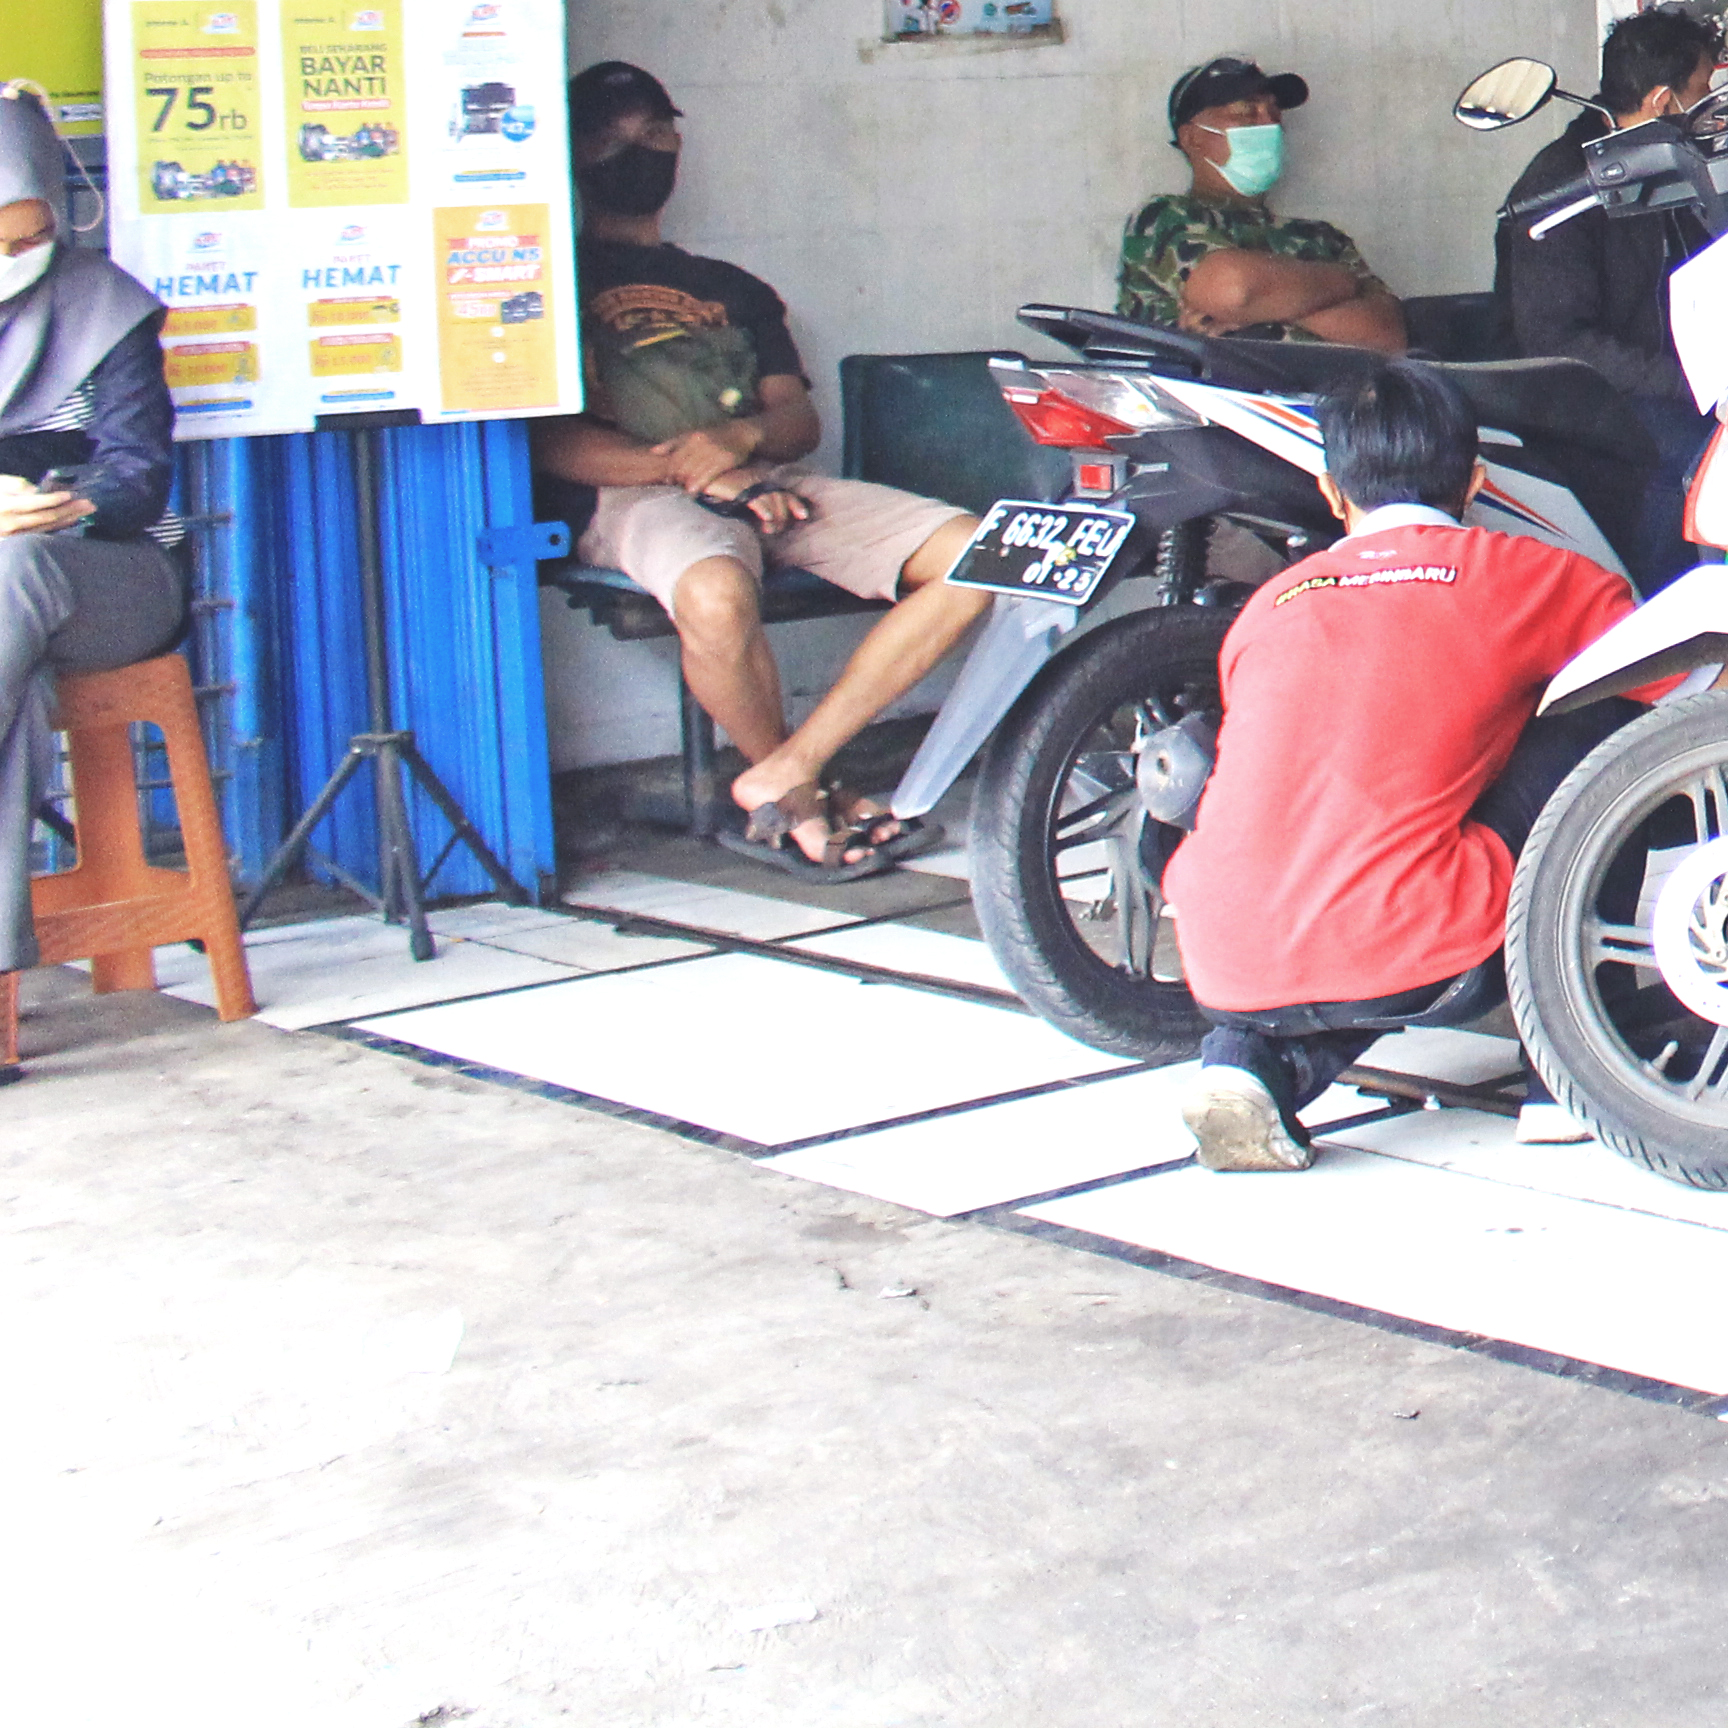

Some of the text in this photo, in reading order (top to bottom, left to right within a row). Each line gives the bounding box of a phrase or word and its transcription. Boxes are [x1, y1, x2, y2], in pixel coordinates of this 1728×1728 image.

[301, 55, 386, 76] BAYAR
[144, 72, 251, 85] Potongan up to
[303, 77, 387, 97] NANTI
[145, 86, 247, 133] 75 rb
[447, 250, 507, 265] ACCU
[156, 272, 258, 297] HEMAT
[301, 265, 401, 289] HEMAT
[977, 509, 1008, 542] F
[1002, 511, 1068, 550] 6632
